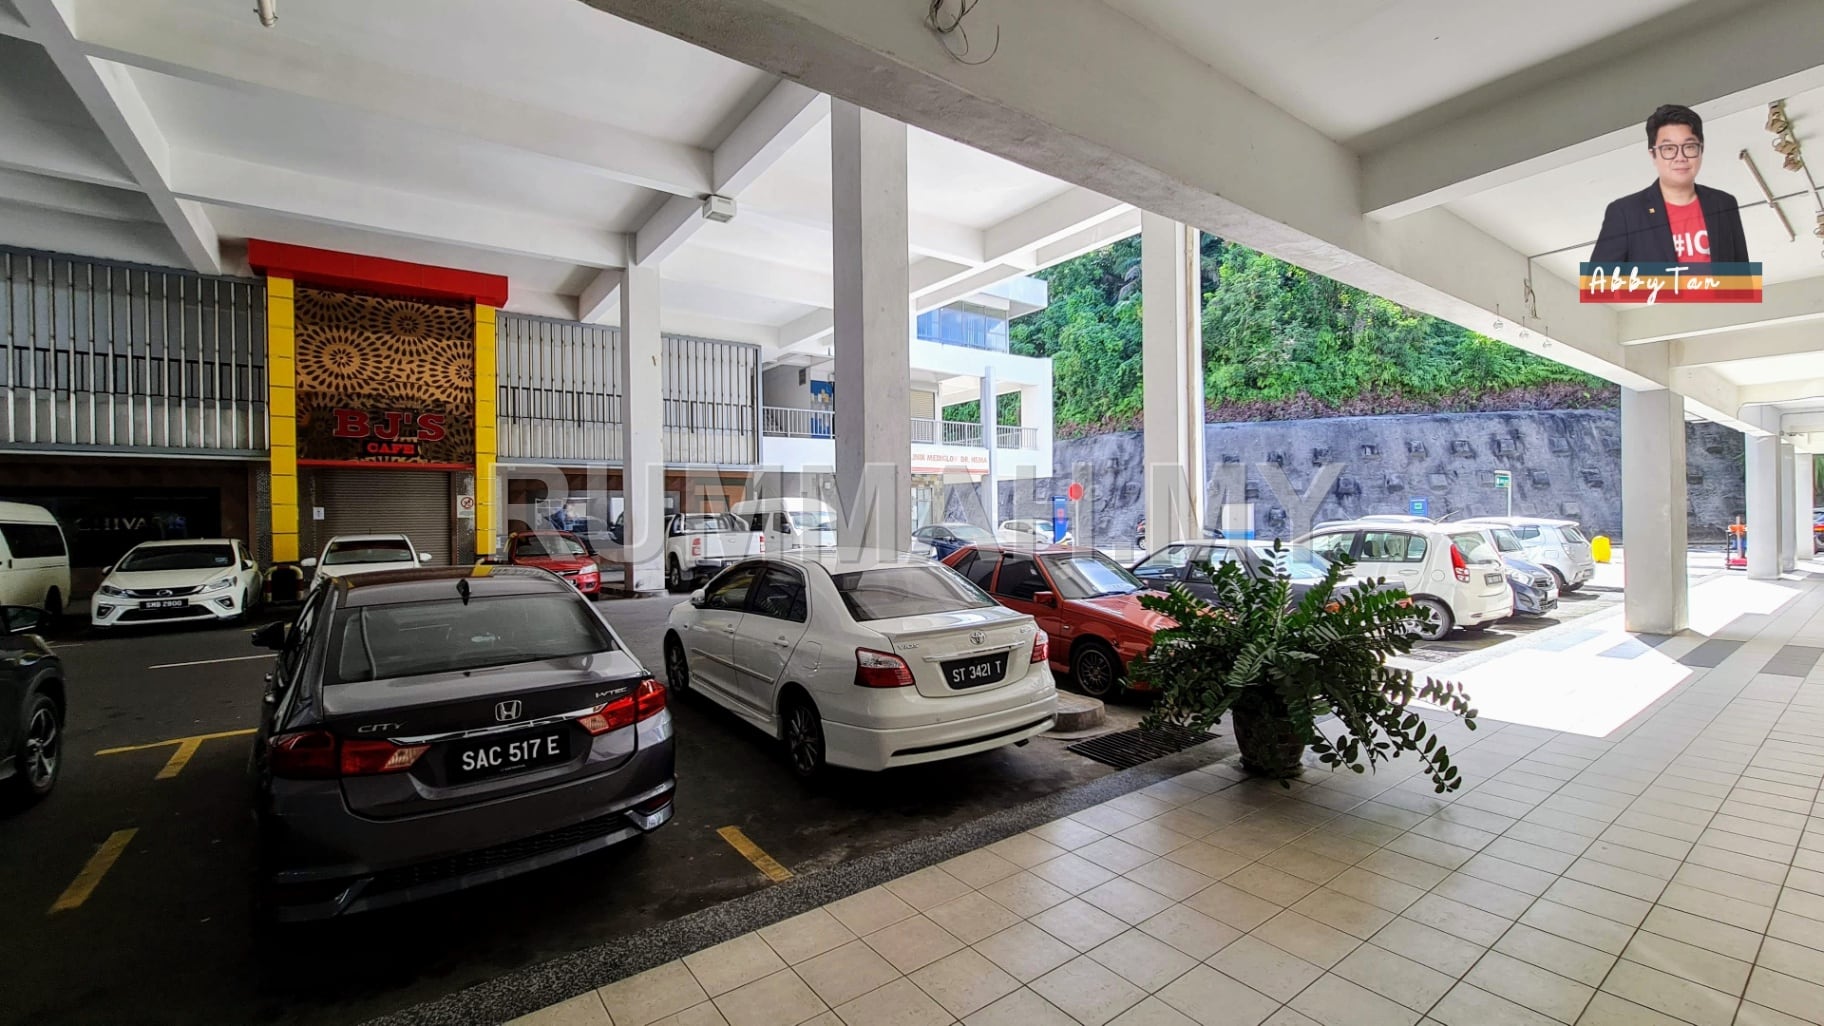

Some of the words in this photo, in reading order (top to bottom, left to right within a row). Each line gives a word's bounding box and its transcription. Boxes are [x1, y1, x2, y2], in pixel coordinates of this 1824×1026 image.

[333, 408, 446, 442] BJ'S
[367, 442, 415, 455] CAFE
[952, 668, 966, 683] ST
[970, 663, 992, 679] 3421
[996, 661, 1001, 674] T
[358, 721, 407, 733] CITY
[462, 747, 502, 771] SAC
[509, 738, 542, 762] 517
[547, 736, 560, 755] E
